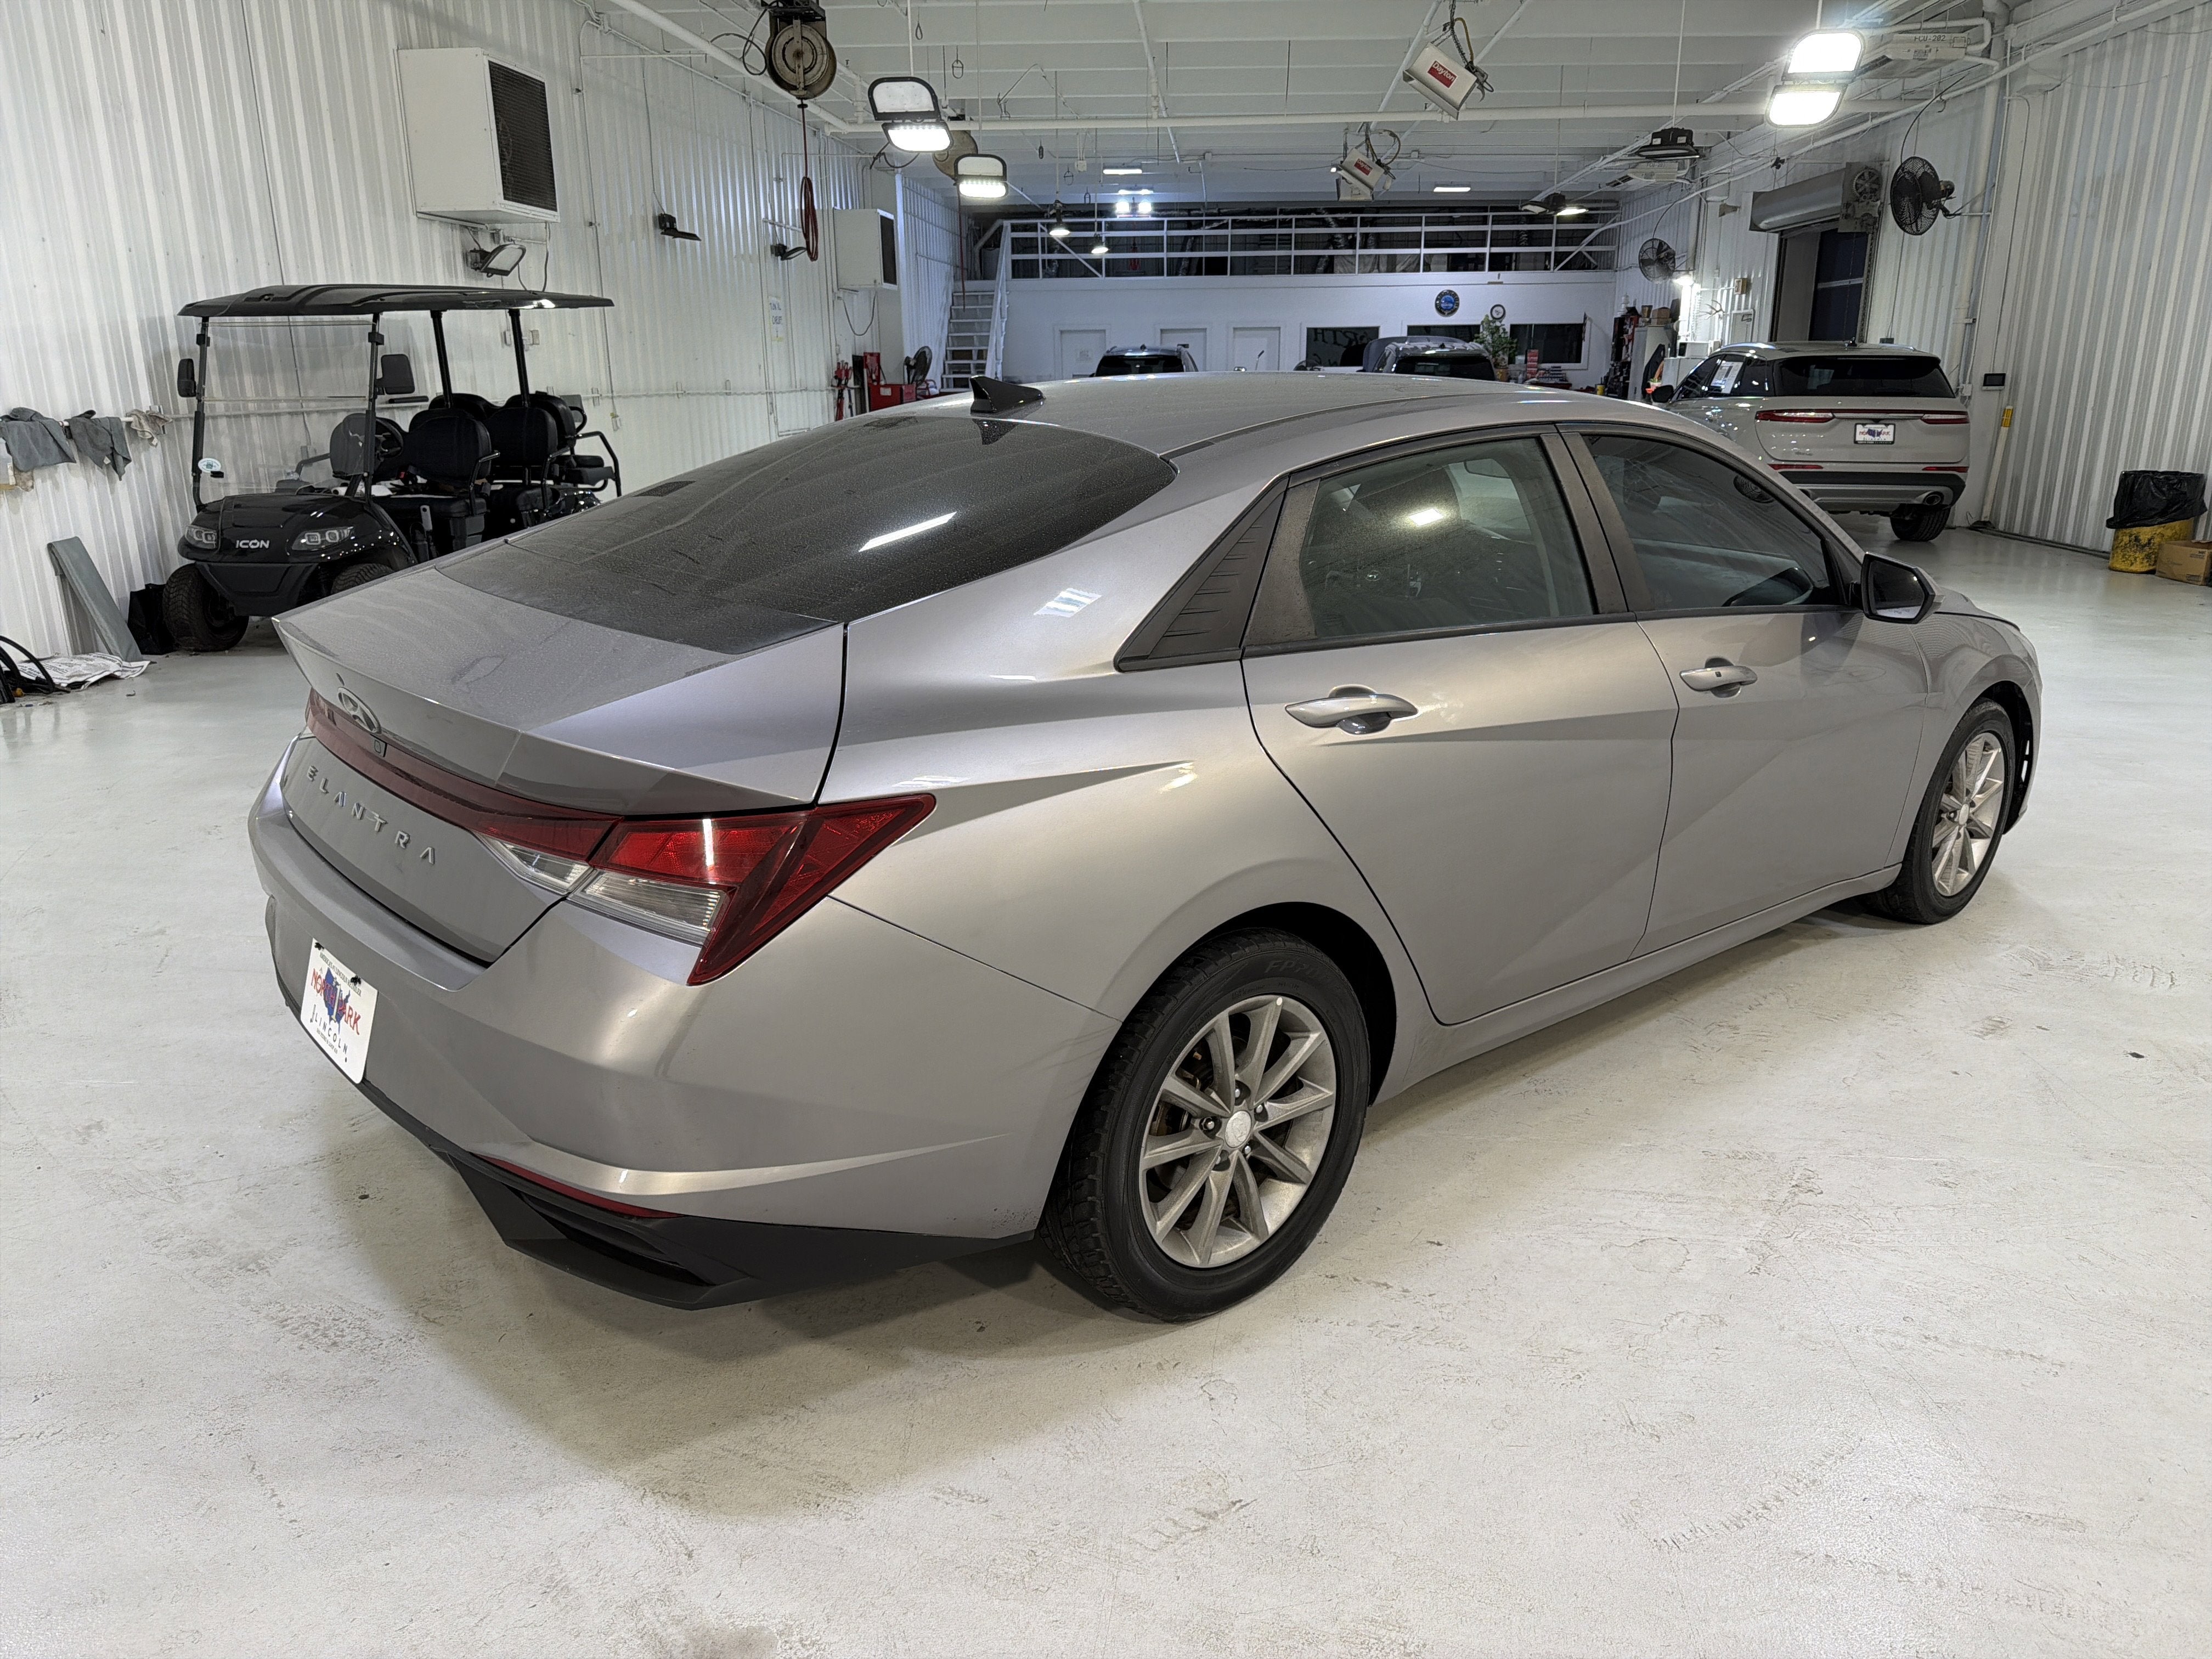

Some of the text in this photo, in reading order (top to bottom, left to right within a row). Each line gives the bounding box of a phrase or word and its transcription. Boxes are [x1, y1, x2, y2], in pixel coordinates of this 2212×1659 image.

[1432, 62, 1455, 82] Dayton
[235, 539, 270, 549] ICON
[307, 765, 436, 865] ELANTRA
[335, 967, 348, 983] LINCOLN
[311, 968, 361, 1035] NORTH PARK
[315, 1012, 348, 1054] LINCOLN
